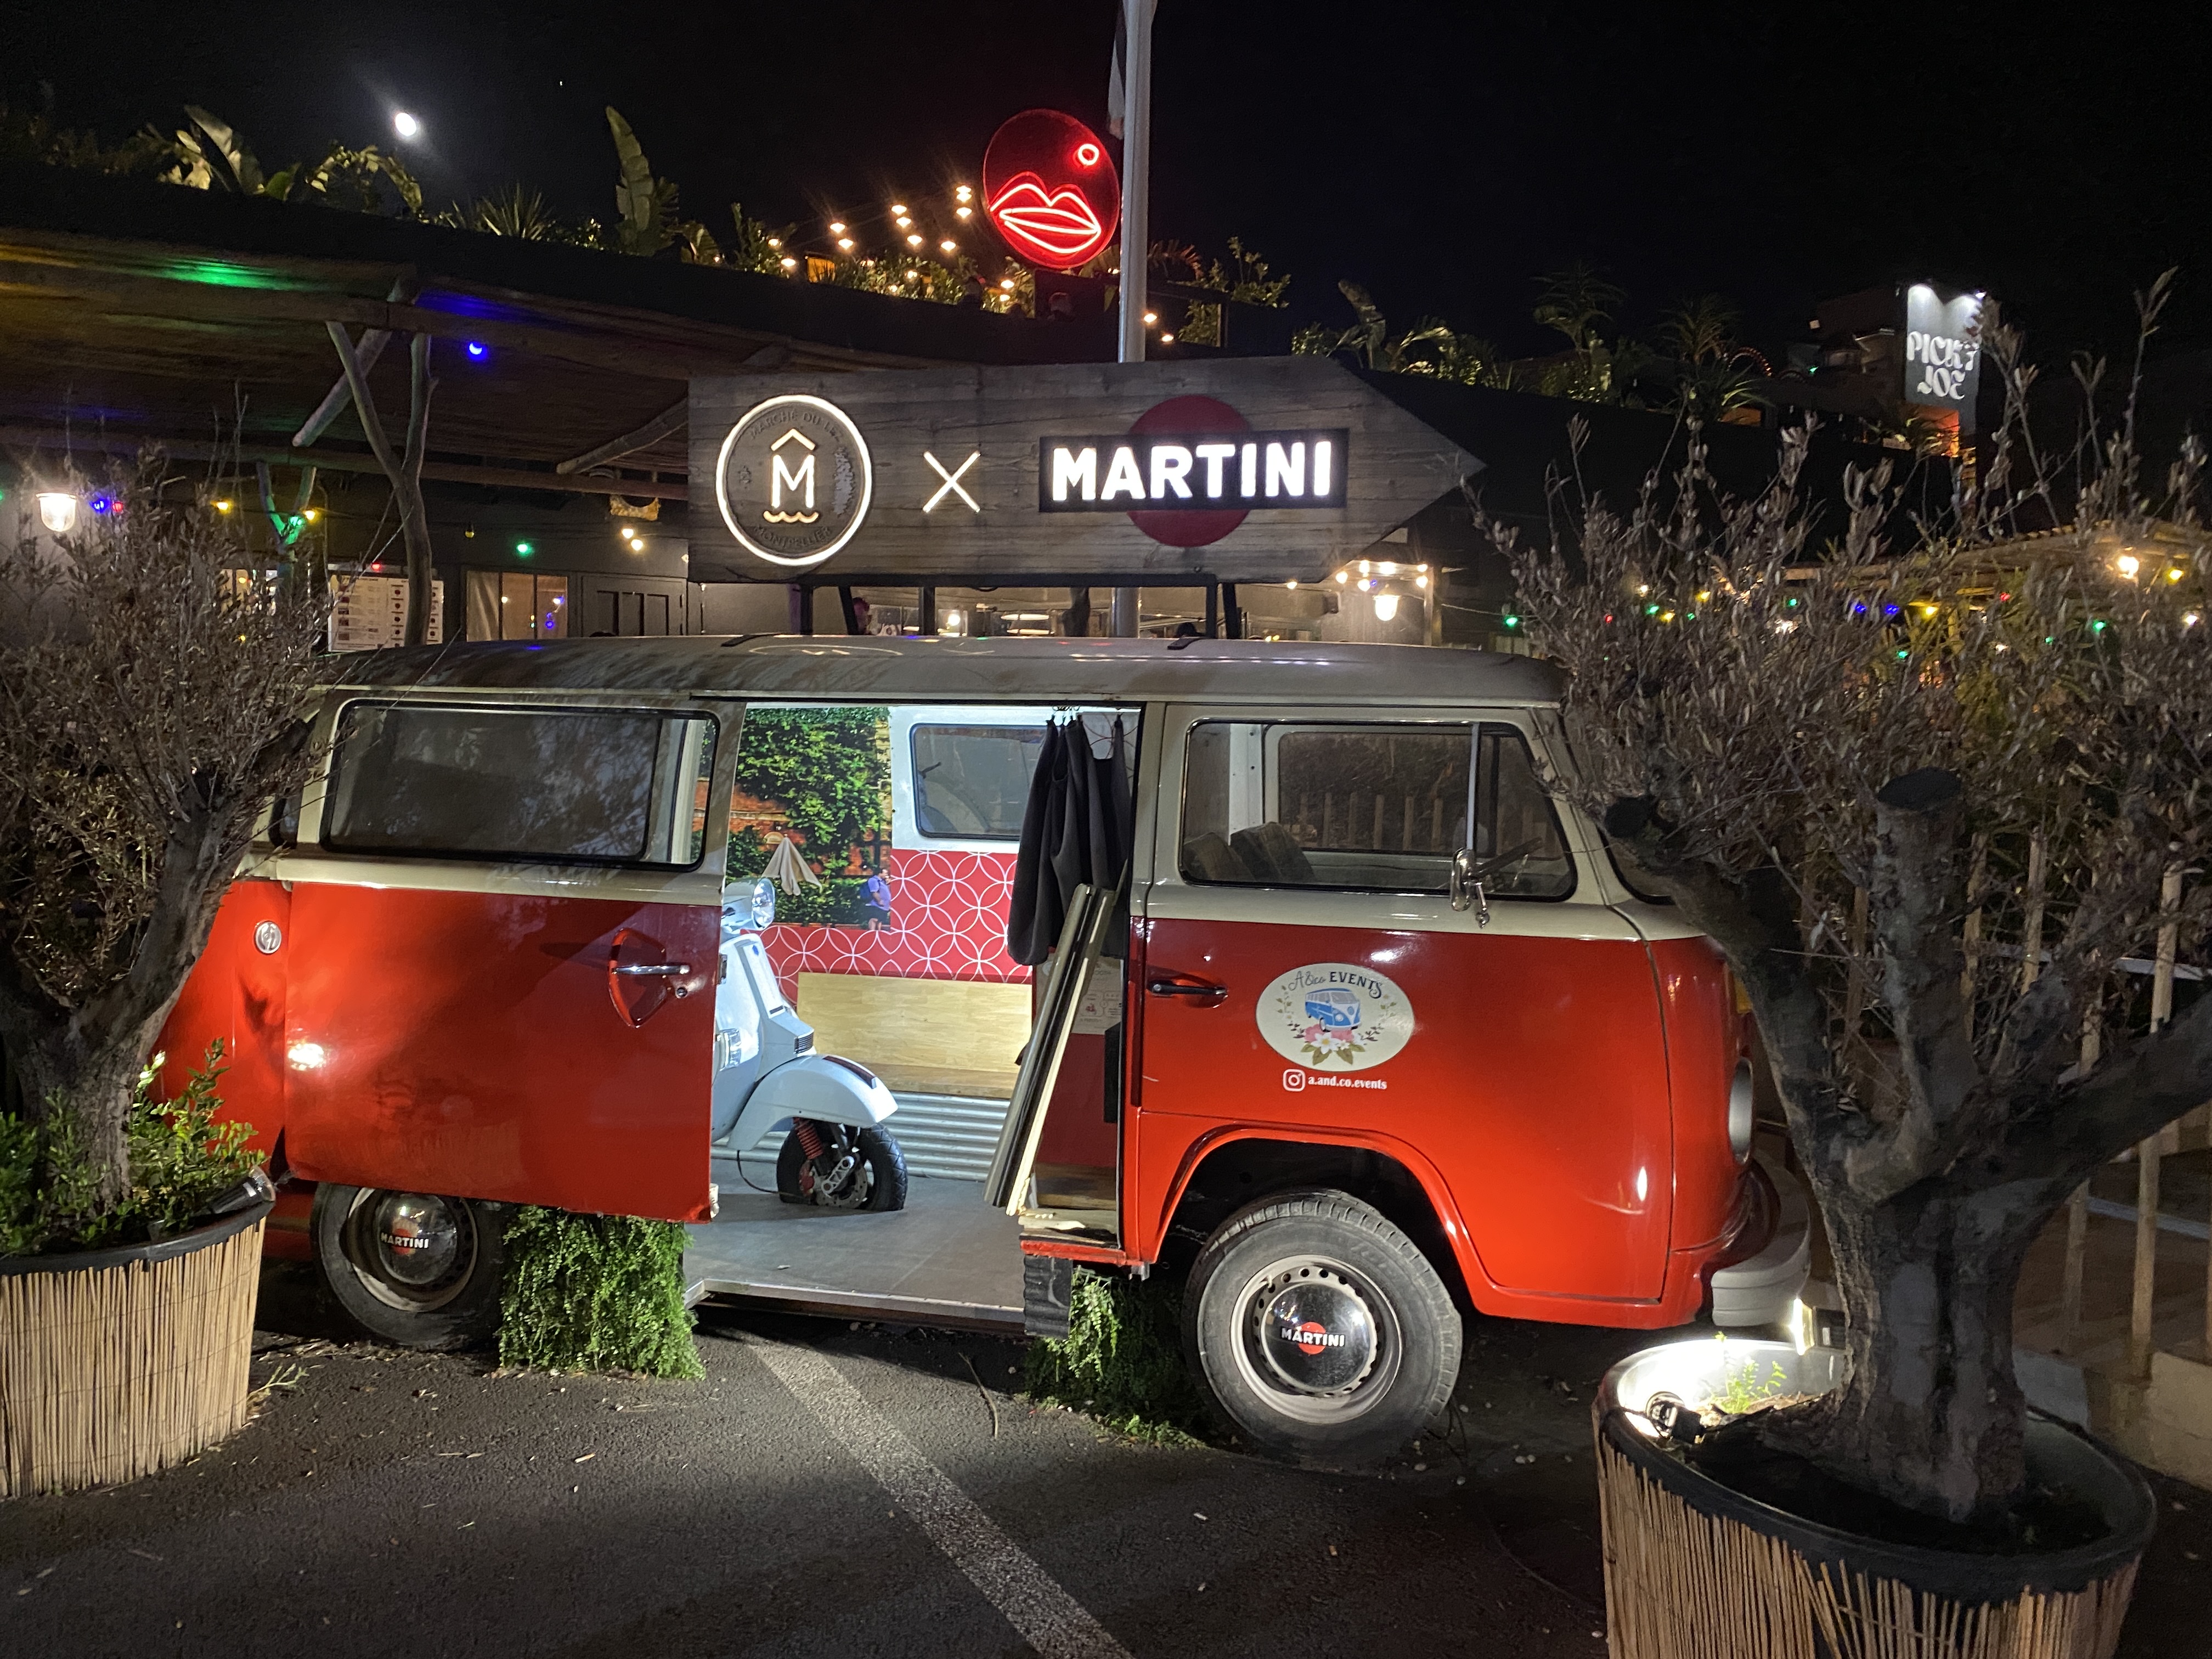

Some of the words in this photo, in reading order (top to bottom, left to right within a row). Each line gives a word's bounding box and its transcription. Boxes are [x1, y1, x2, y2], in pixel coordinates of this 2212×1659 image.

[1917, 365, 1966, 400] JOE
[803, 412, 821, 426] DU
[1052, 441, 1333, 502] MARTINI
[1329, 971, 1383, 999] EVENTS
[1307, 1075, 1388, 1090] a.and.co.events
[381, 1232, 430, 1249] MARTINI
[1281, 1328, 1345, 1347] MARTINI
